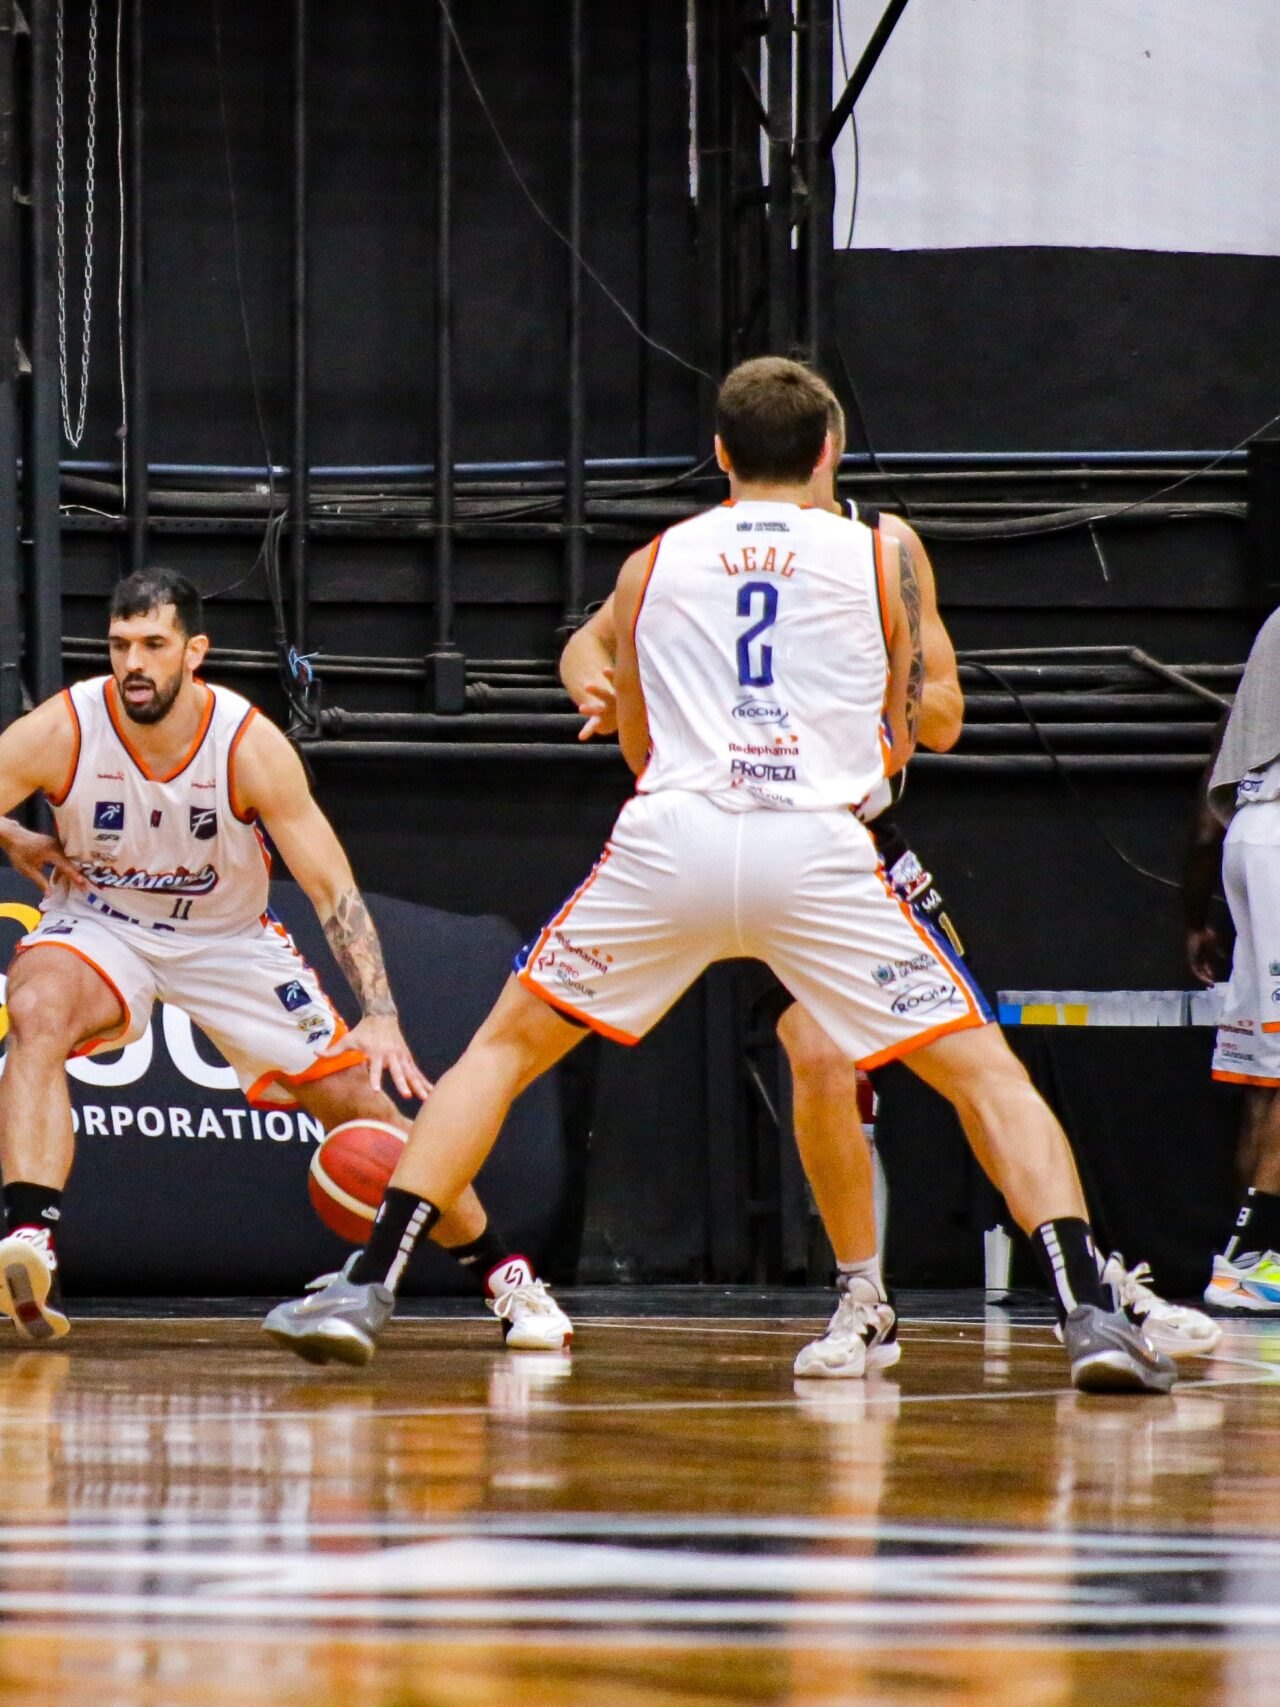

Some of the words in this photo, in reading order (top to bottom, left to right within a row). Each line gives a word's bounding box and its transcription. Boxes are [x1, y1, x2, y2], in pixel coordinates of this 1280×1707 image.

[720, 546, 796, 578] LEAL
[736, 581, 778, 688] 2
[169, 898, 193, 921] 11
[70, 1105, 326, 1143] RPORATION
